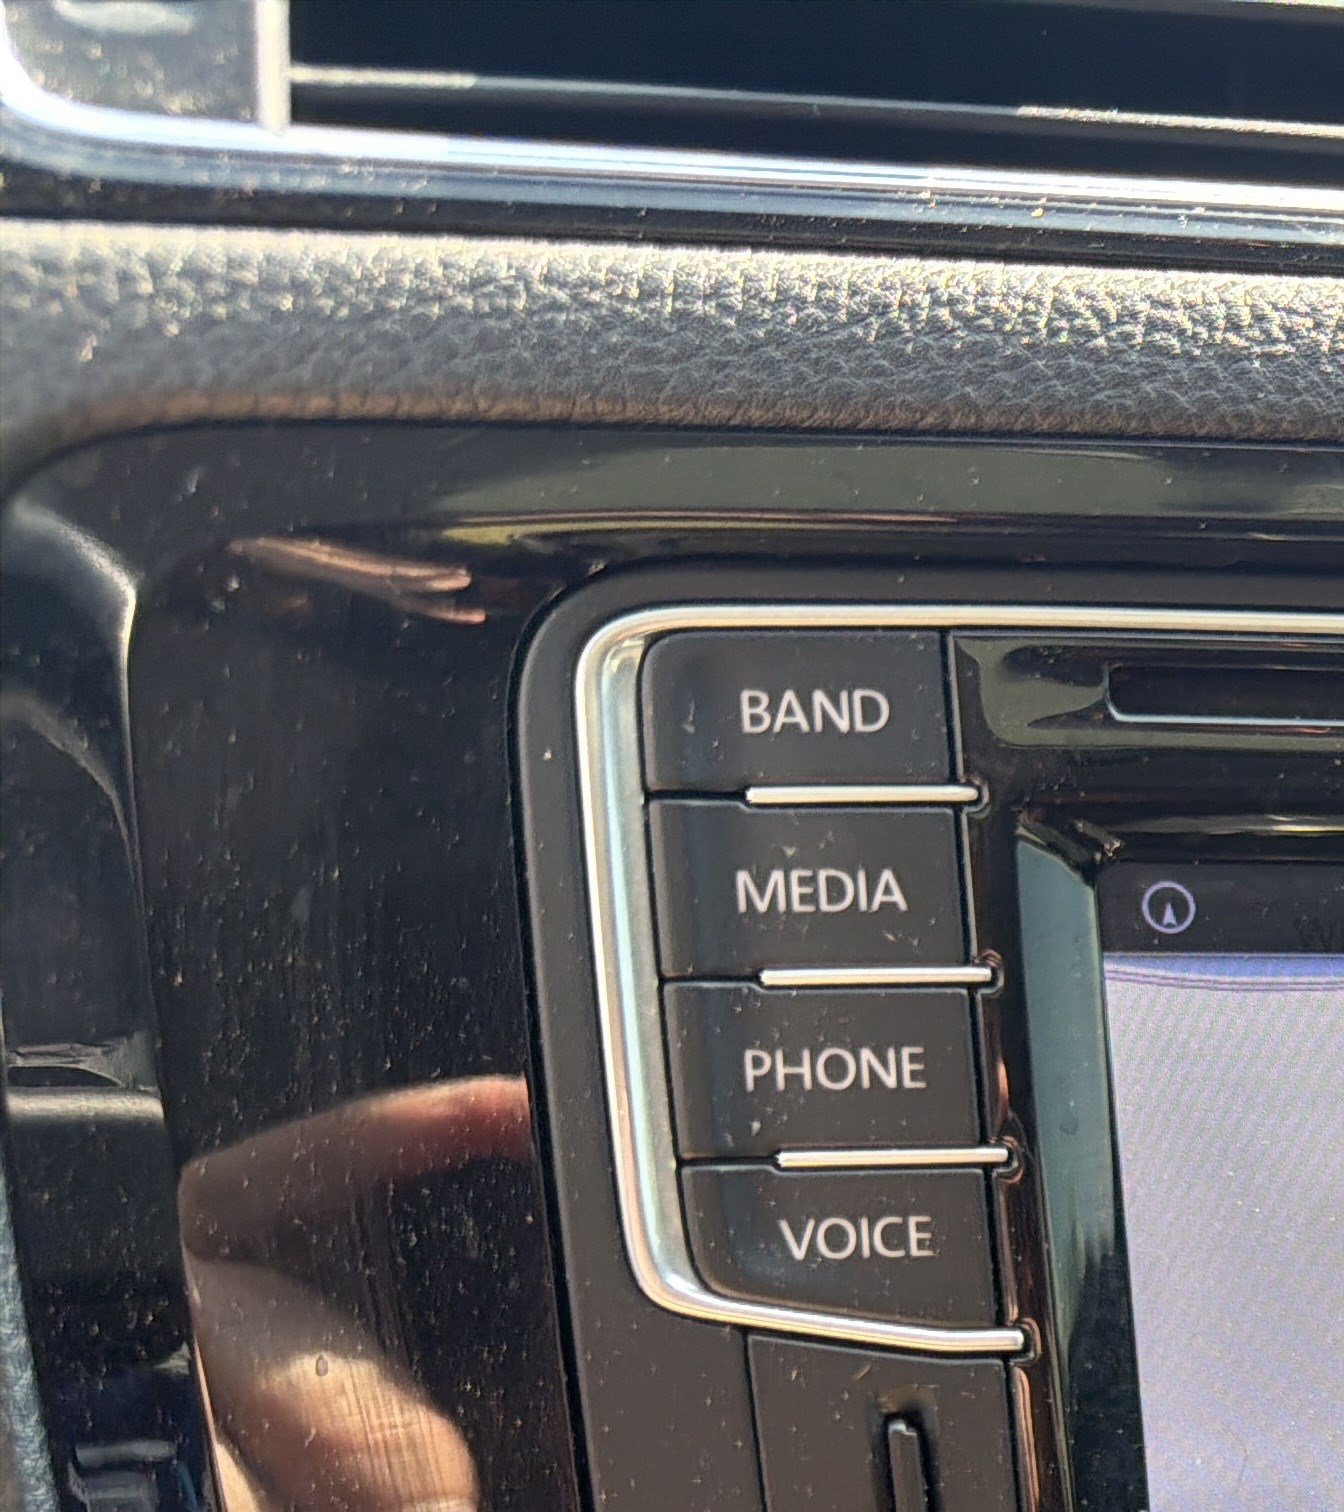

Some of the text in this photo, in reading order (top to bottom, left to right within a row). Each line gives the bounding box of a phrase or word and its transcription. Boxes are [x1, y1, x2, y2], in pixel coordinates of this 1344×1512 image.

[740, 689, 890, 734] BAND
[736, 868, 909, 914] MEDIA
[743, 1046, 927, 1092] PHONE
[779, 1215, 935, 1260] VOICE
